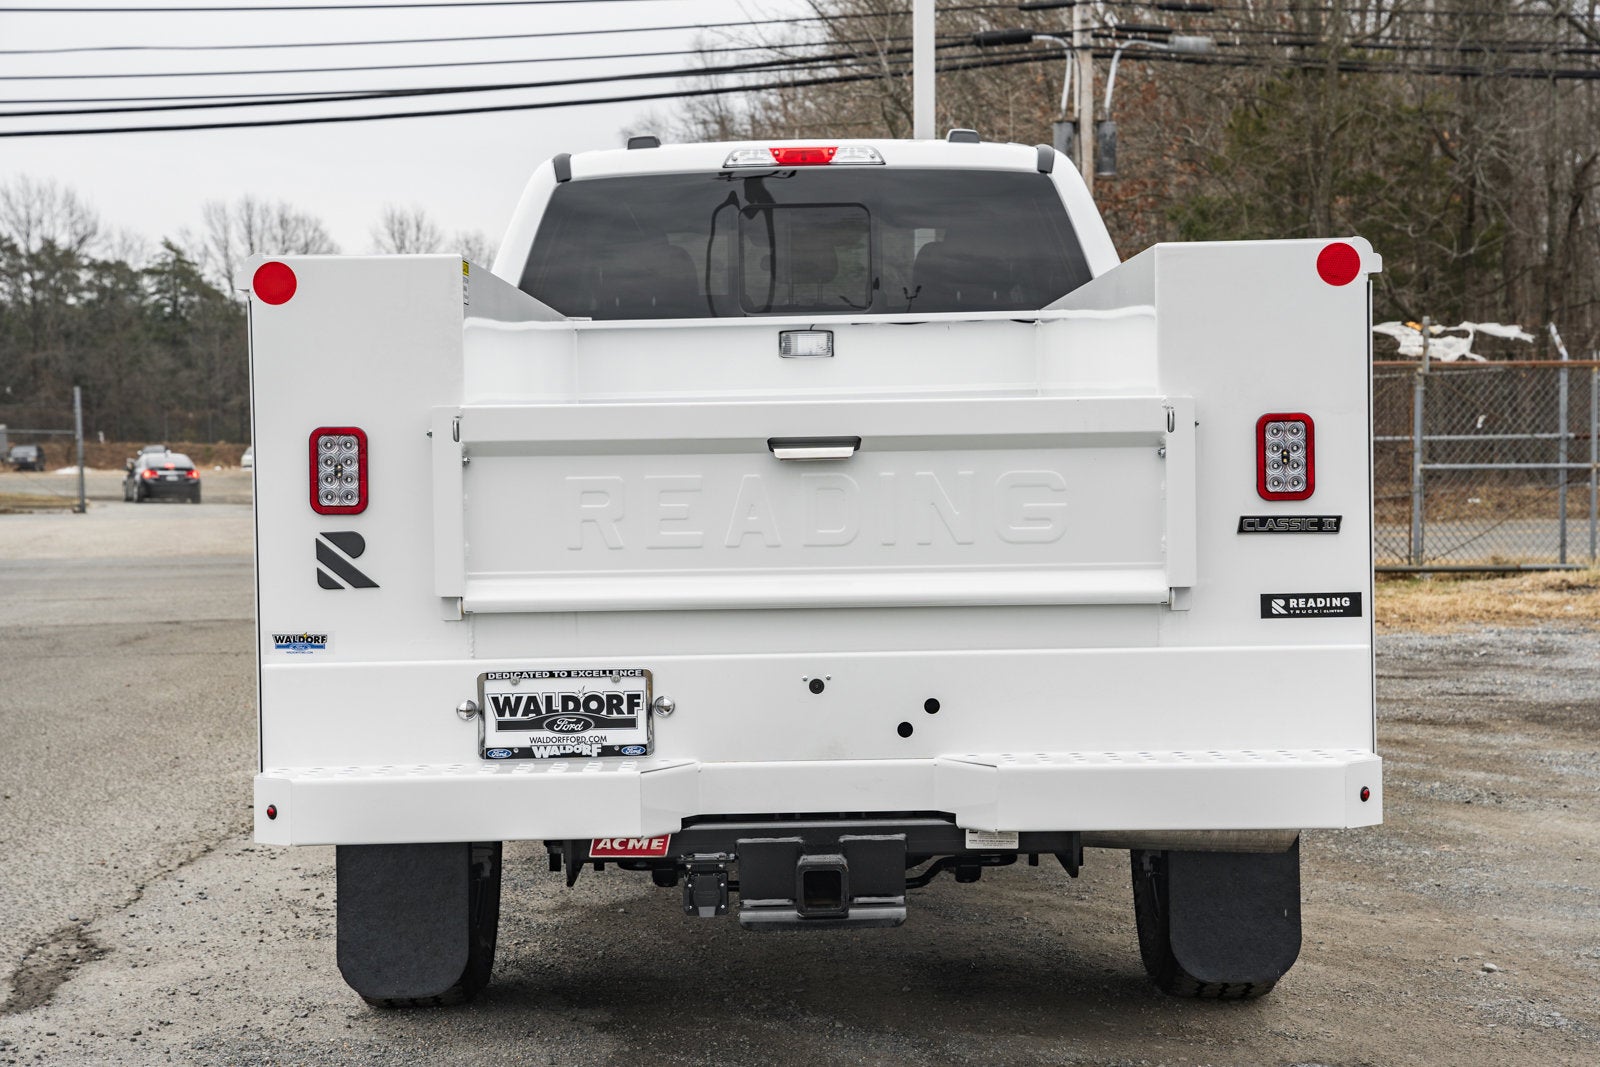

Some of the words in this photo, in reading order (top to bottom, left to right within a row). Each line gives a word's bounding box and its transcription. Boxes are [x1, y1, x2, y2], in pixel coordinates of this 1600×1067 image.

[565, 470, 1068, 550] READING
[1242, 518, 1318, 531] CLASSIC
[1322, 518, 1337, 531] II
[1289, 597, 1350, 608] READING
[273, 634, 327, 644] WALDORF
[488, 671, 550, 680] DEDICATED
[571, 669, 642, 677] EXCELLENCE
[490, 693, 642, 718] WALDORF
[553, 718, 585, 732] Ford
[529, 735, 608, 744] WALDORFFORD.COM
[532, 744, 602, 758] WALDORF
[595, 838, 665, 850] ACME
